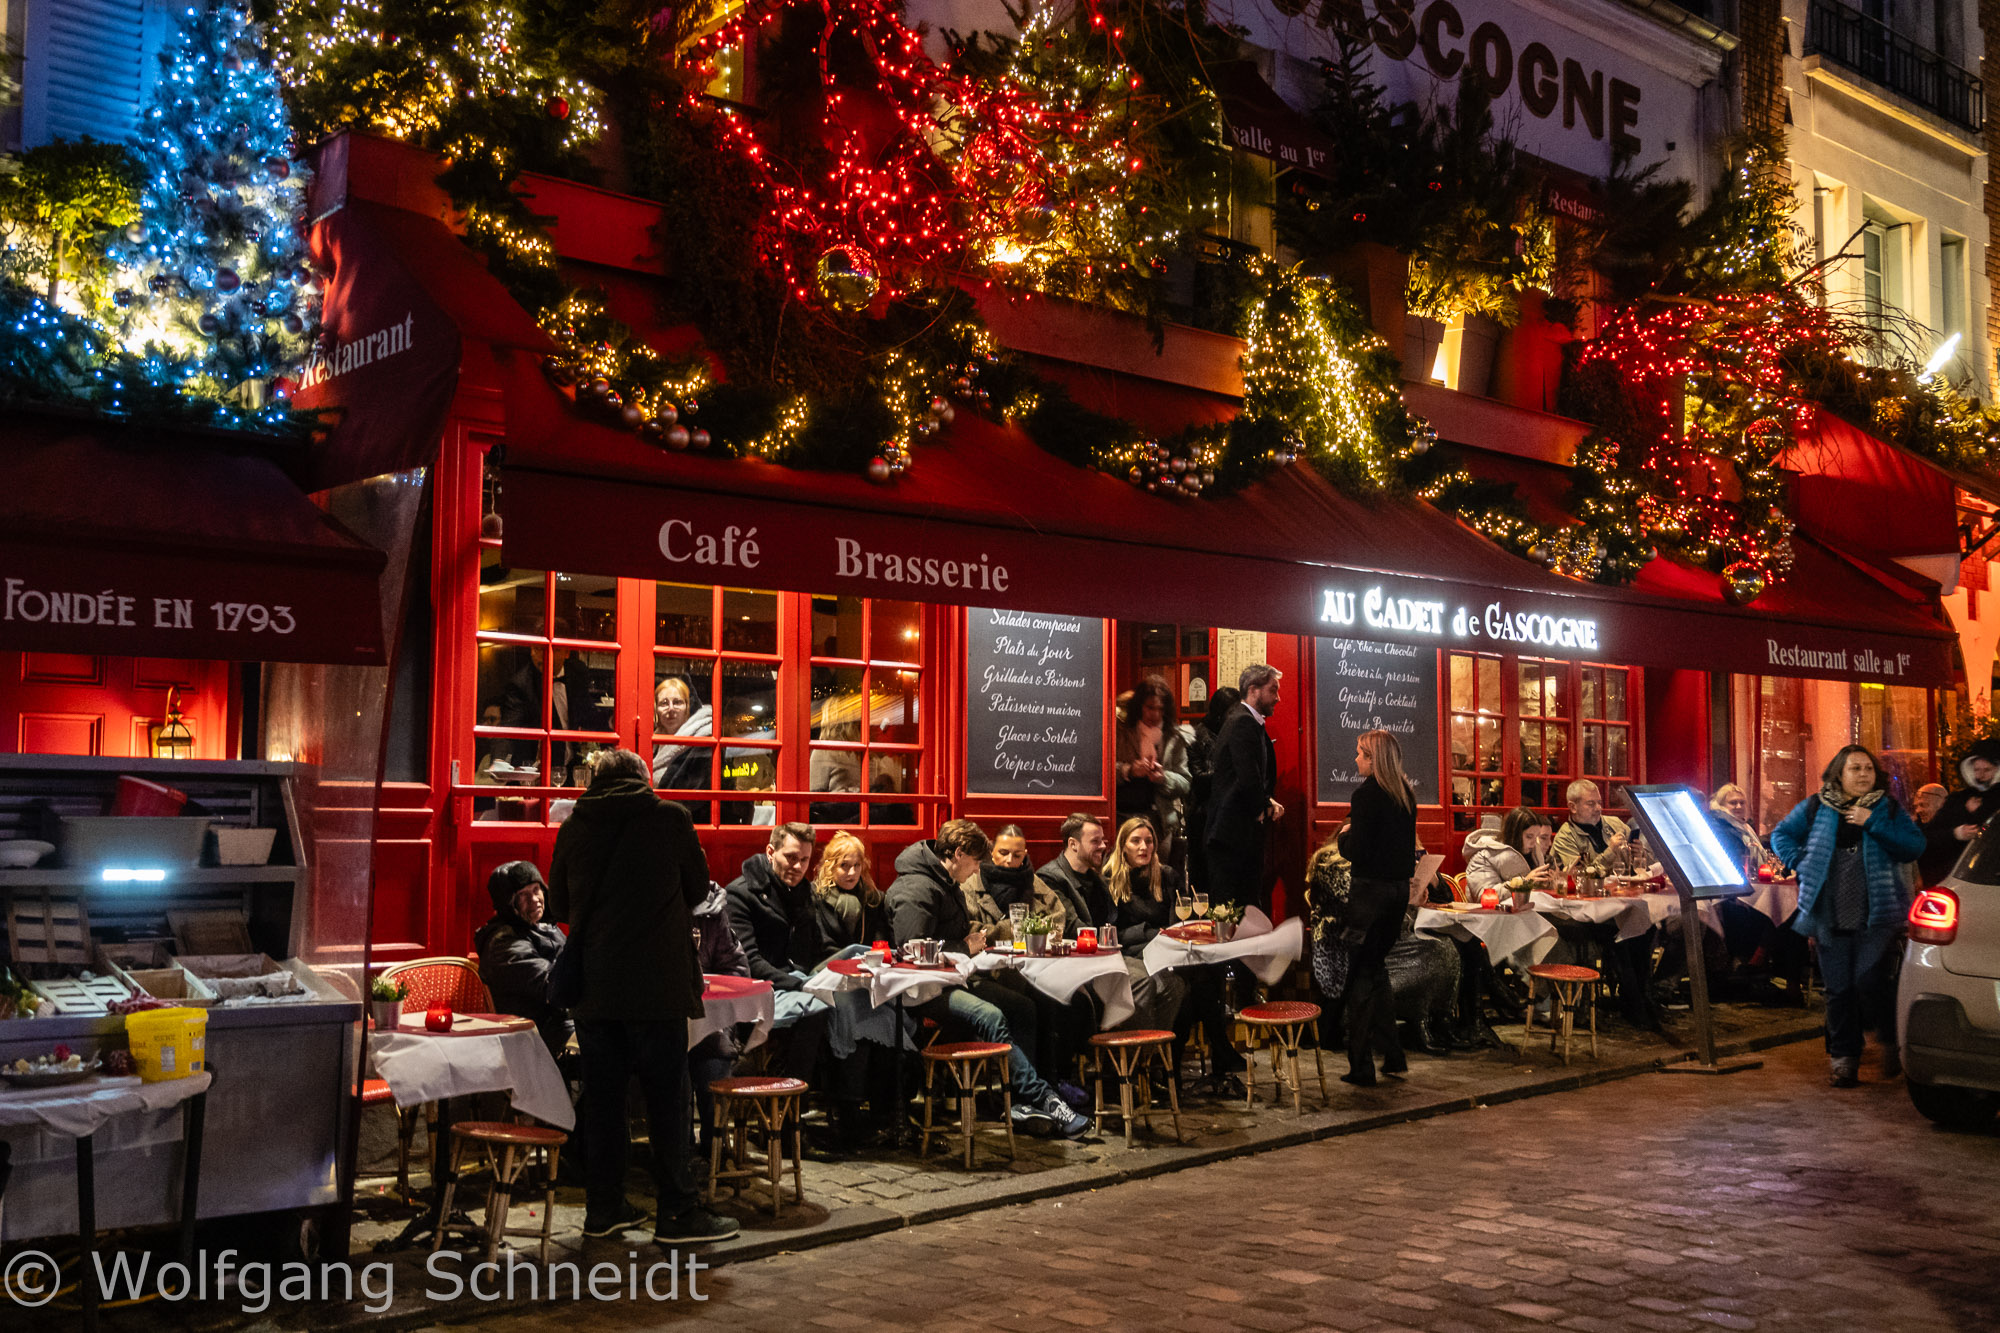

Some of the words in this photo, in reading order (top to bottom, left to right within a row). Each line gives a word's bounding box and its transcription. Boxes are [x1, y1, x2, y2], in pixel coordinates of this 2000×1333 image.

[1232, 125, 1272, 154] salle
[1280, 144, 1298, 163] au
[1305, 146, 1326, 169] 1er
[300, 310, 414, 391] Restaurant
[658, 518, 760, 569] Café
[835, 536, 1010, 593] Brasserie
[4, 577, 136, 627] FONDÉE
[154, 599, 194, 630] EN
[210, 602, 297, 635] 1793
[1321, 590, 1355, 625] AU
[1364, 586, 1445, 635] CADET
[1453, 607, 1480, 637] de
[1485, 602, 1598, 650] GASCOGNE
[990, 608, 1031, 628] Salades
[1033, 617, 1081, 637] composées
[994, 636, 1025, 654] Plats
[1027, 644, 1039, 657] du
[1038, 639, 1074, 666] jour
[1384, 643, 1418, 658] Chocolat
[1767, 639, 1848, 671] Restaurant
[1853, 649, 1880, 673] salle
[1884, 658, 1894, 675] au
[1897, 652, 1911, 676] 1er
[981, 665, 1034, 693] Grillades
[1035, 676, 1043, 685] &
[1043, 669, 1086, 688] Poissons
[1336, 659, 1369, 678] Bières
[1369, 670, 1375, 679] à
[1375, 667, 1383, 680] la
[1385, 672, 1420, 687] pression
[1047, 703, 1081, 717] maison
[1338, 687, 1376, 713] Apéritifs
[1385, 692, 1417, 709] Cocktails
[1340, 711, 1361, 730] Vins
[1362, 719, 1371, 730] de
[996, 725, 1031, 750] Glaces
[1033, 734, 1041, 743] &
[1042, 726, 1077, 745] Sorbets
[994, 752, 1035, 779] Crêpes
[1044, 754, 1076, 773] Snack
[1330, 769, 1349, 783] Salle
